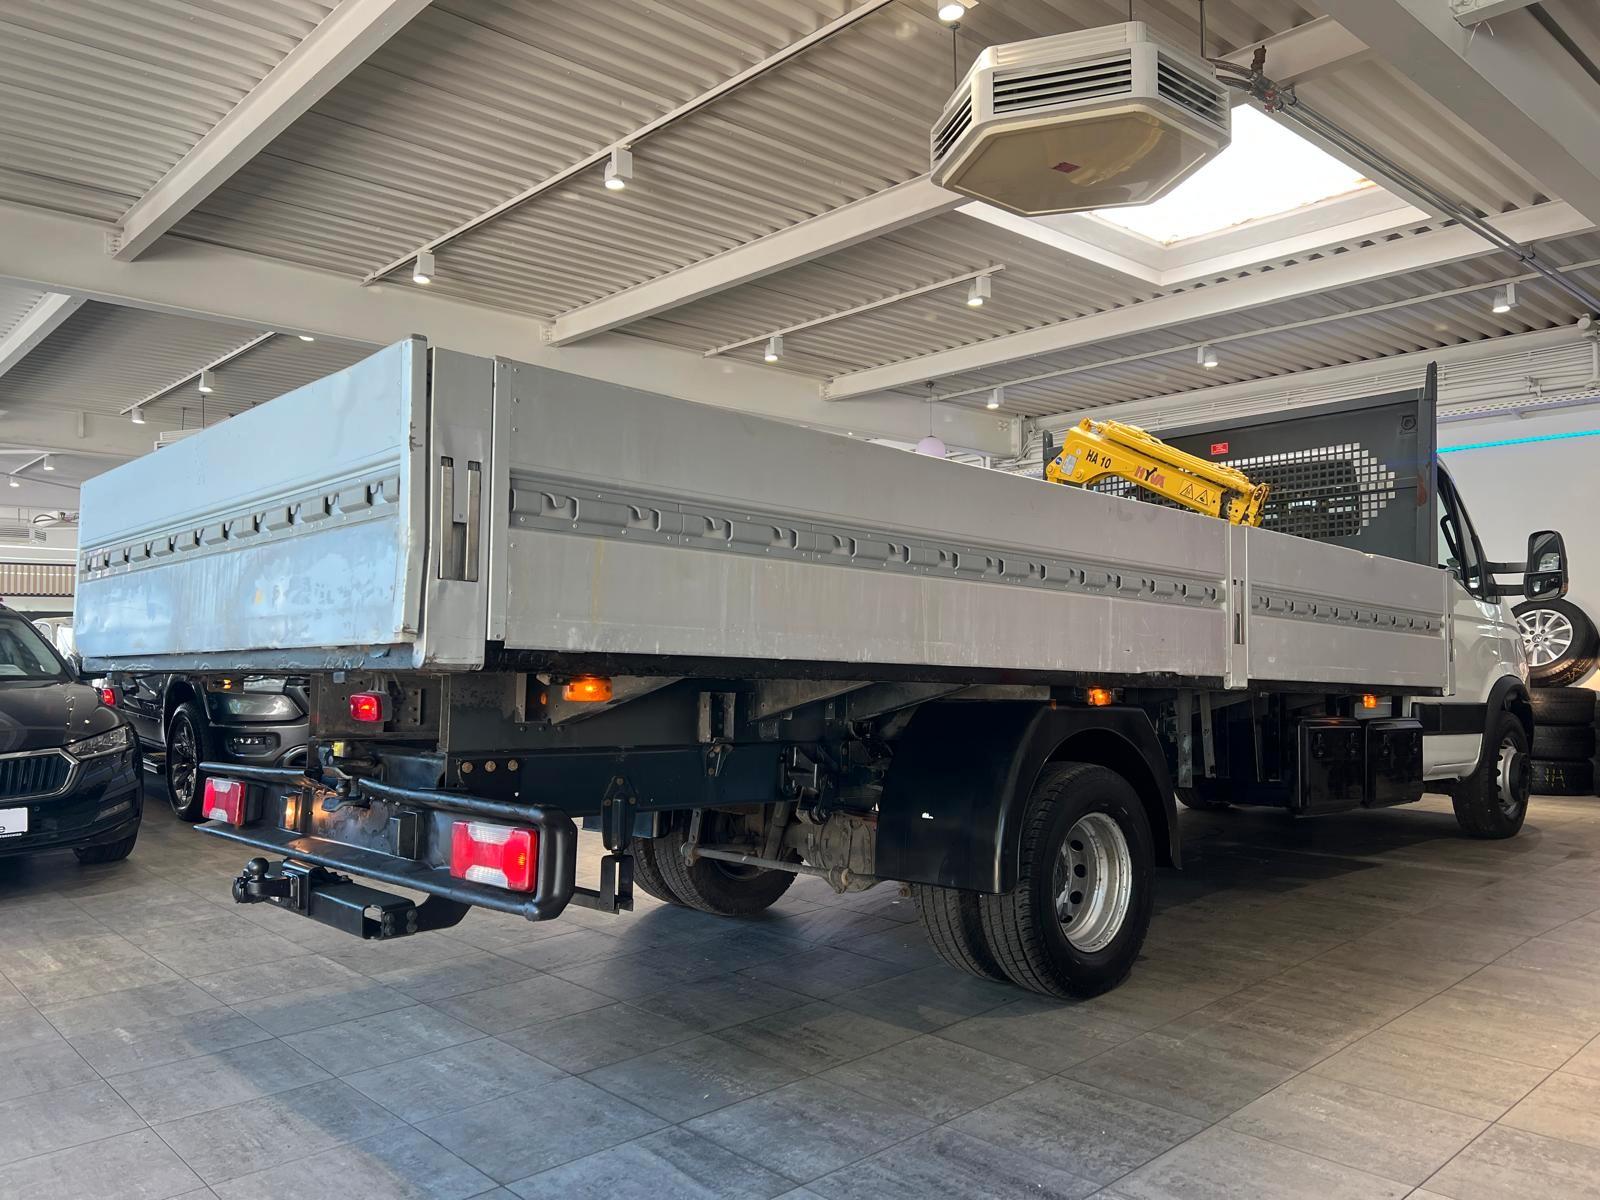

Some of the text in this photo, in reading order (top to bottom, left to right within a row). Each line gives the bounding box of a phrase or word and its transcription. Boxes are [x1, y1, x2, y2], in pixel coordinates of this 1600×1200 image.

[1086, 449, 1099, 465] HA
[1100, 455, 1112, 469] 10
[1134, 465, 1166, 488] HYVA
